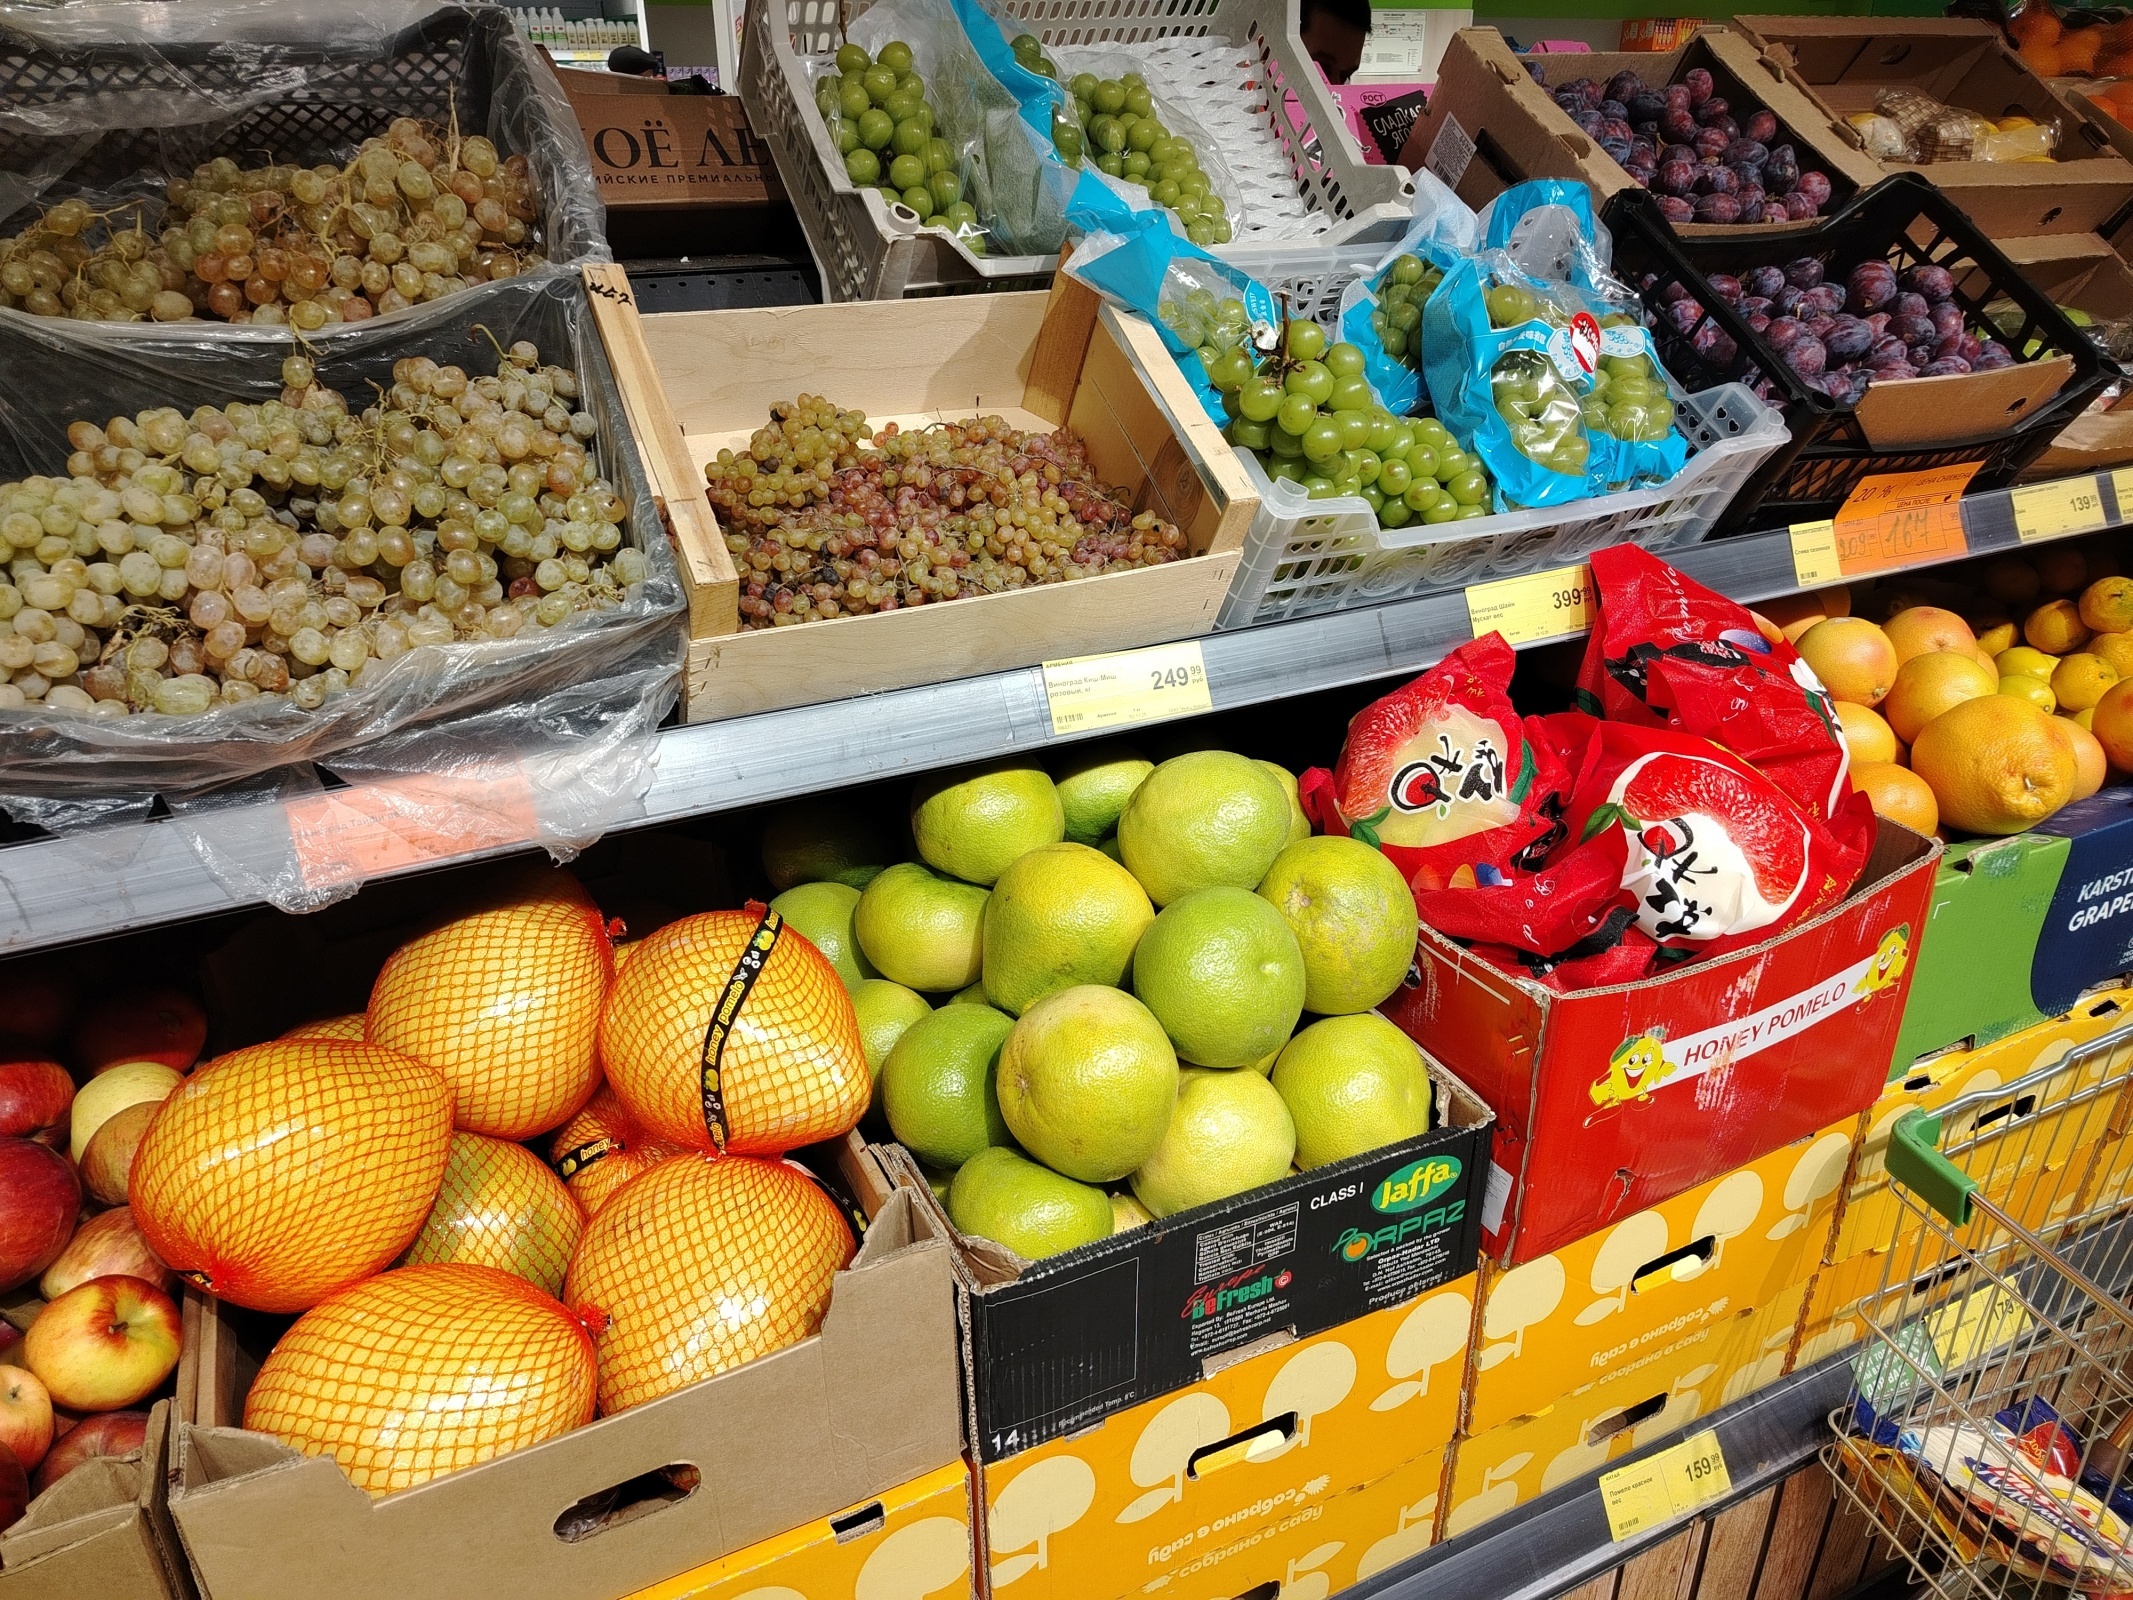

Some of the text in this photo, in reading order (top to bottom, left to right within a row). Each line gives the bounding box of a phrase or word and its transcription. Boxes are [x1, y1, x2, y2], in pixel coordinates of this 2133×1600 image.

[1362, 94, 1384, 103] РОСТ
[583, 119, 679, 169] ОЁ
[1916, 476, 1936, 487] ЦЕНА
[1912, 498, 1931, 507] ПОСЛЕ
[2070, 495, 2091, 512] 139
[1950, 511, 1959, 520] 99
[1470, 604, 1498, 615] Виноград
[1552, 588, 1581, 609] 399
[1472, 614, 1493, 623] Мускат
[1048, 674, 1117, 690] Виноград Киш-Миш
[1150, 665, 1202, 690] 249 99
[1192, 676, 1204, 684] руб
[2077, 867, 2133, 903] KARST
[2068, 893, 2133, 932] GRAPE
[704, 980, 746, 1066] honey pomelo
[1683, 982, 1846, 1067] HONEY POMELO
[580, 1137, 611, 1162] honey
[1310, 1181, 1364, 1210] CLASS I
[1379, 1162, 1450, 1209] Jaffa
[1338, 1199, 1466, 1262] ORPAZ
[1425, 1237, 1441, 1247] LTD
[1192, 1276, 1274, 1320] BeFresh
[1590, 1307, 1704, 1368] собрано в саду
[992, 1429, 1020, 1453] 14
[1605, 1472, 1621, 1481] КИТАЙ
[1685, 1453, 1720, 1482] 159 99
[1713, 1462, 1723, 1472] руб
[1610, 1476, 1653, 1498] Помело красное
[1147, 1488, 1297, 1565] собрано в саду
[1179, 1504, 1324, 1579] собрано в саду
